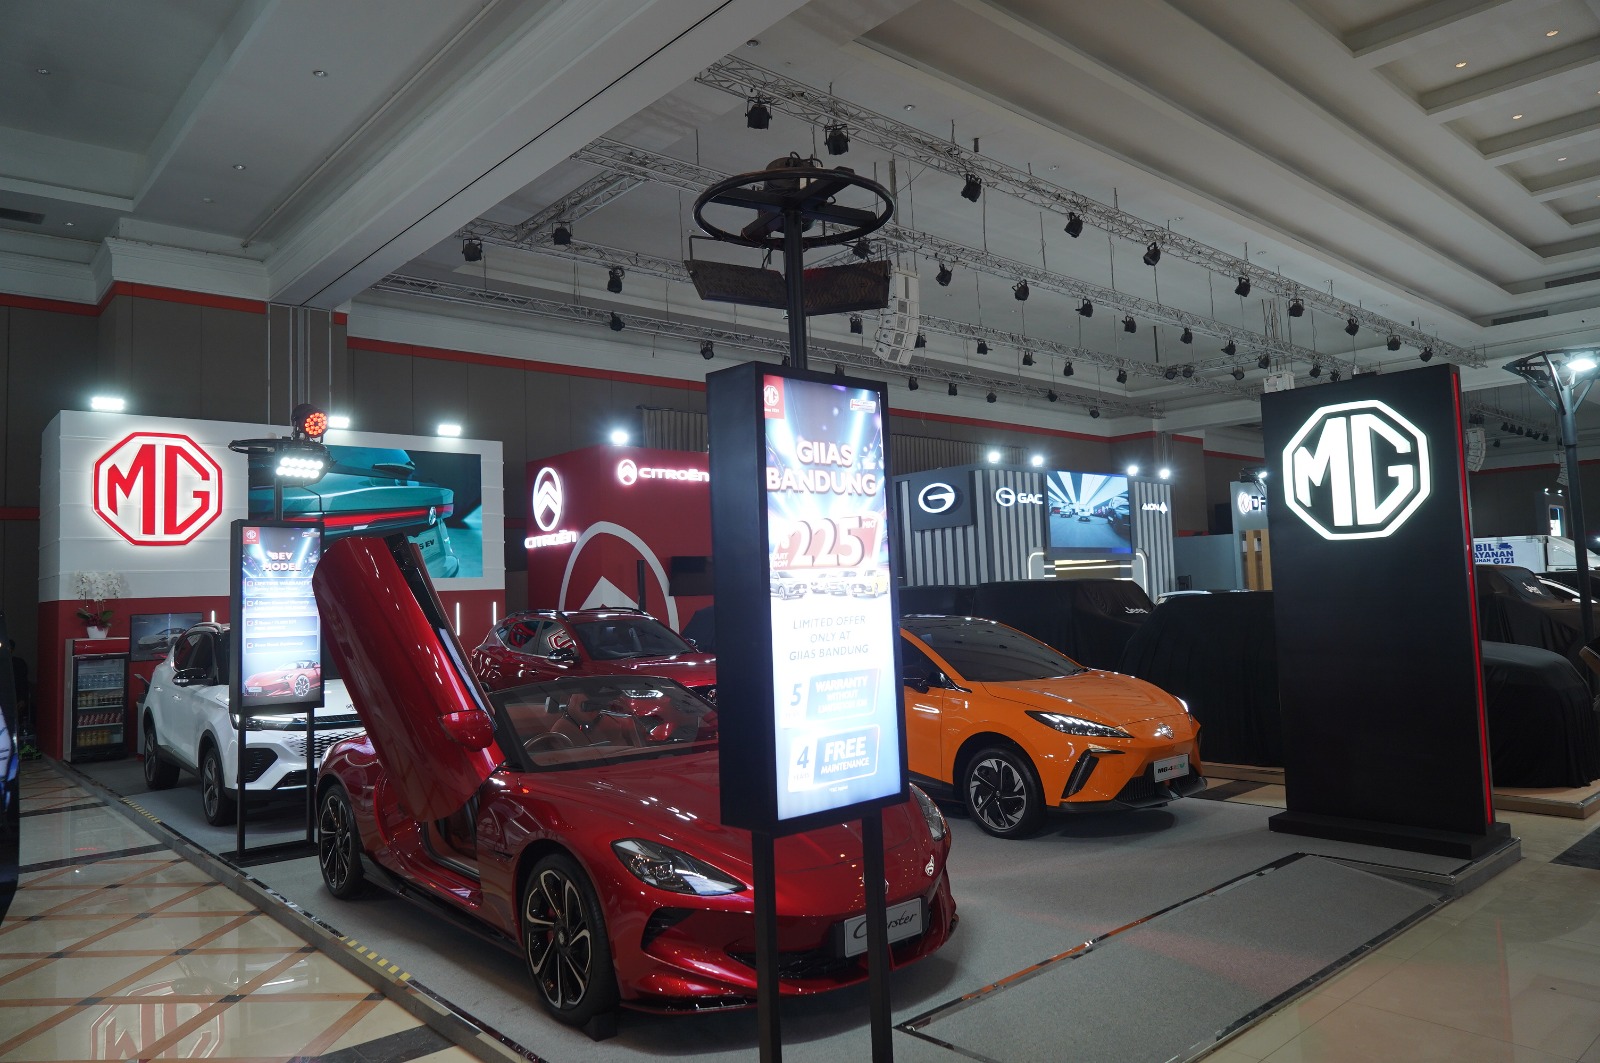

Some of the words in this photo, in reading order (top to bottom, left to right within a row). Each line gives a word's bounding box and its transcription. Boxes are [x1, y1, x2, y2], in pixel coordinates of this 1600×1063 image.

[796, 441, 852, 468] GIIAS
[1294, 413, 1414, 527] MG
[107, 443, 210, 535] MG
[766, 467, 876, 497] BANDUNG
[1017, 492, 1044, 505] GAC
[790, 516, 864, 567] 225
[1475, 543, 1494, 552] BIL
[271, 552, 293, 561] BEV
[1493, 557, 1515, 565] GIZI
[263, 562, 301, 572] MODEL
[793, 619, 834, 630] LIMITED
[836, 615, 866, 626] OFFER
[810, 632, 836, 643] ONLY
[839, 630, 852, 640] AT
[789, 649, 816, 660] GIIAS
[818, 644, 870, 658] BANDUNG
[815, 675, 869, 693] WARRANTY
[790, 683, 802, 706] 5
[796, 746, 809, 768] 4
[824, 736, 867, 763] FREE
[820, 757, 870, 775] MAINTENANCE
[853, 910, 918, 939] Crster
